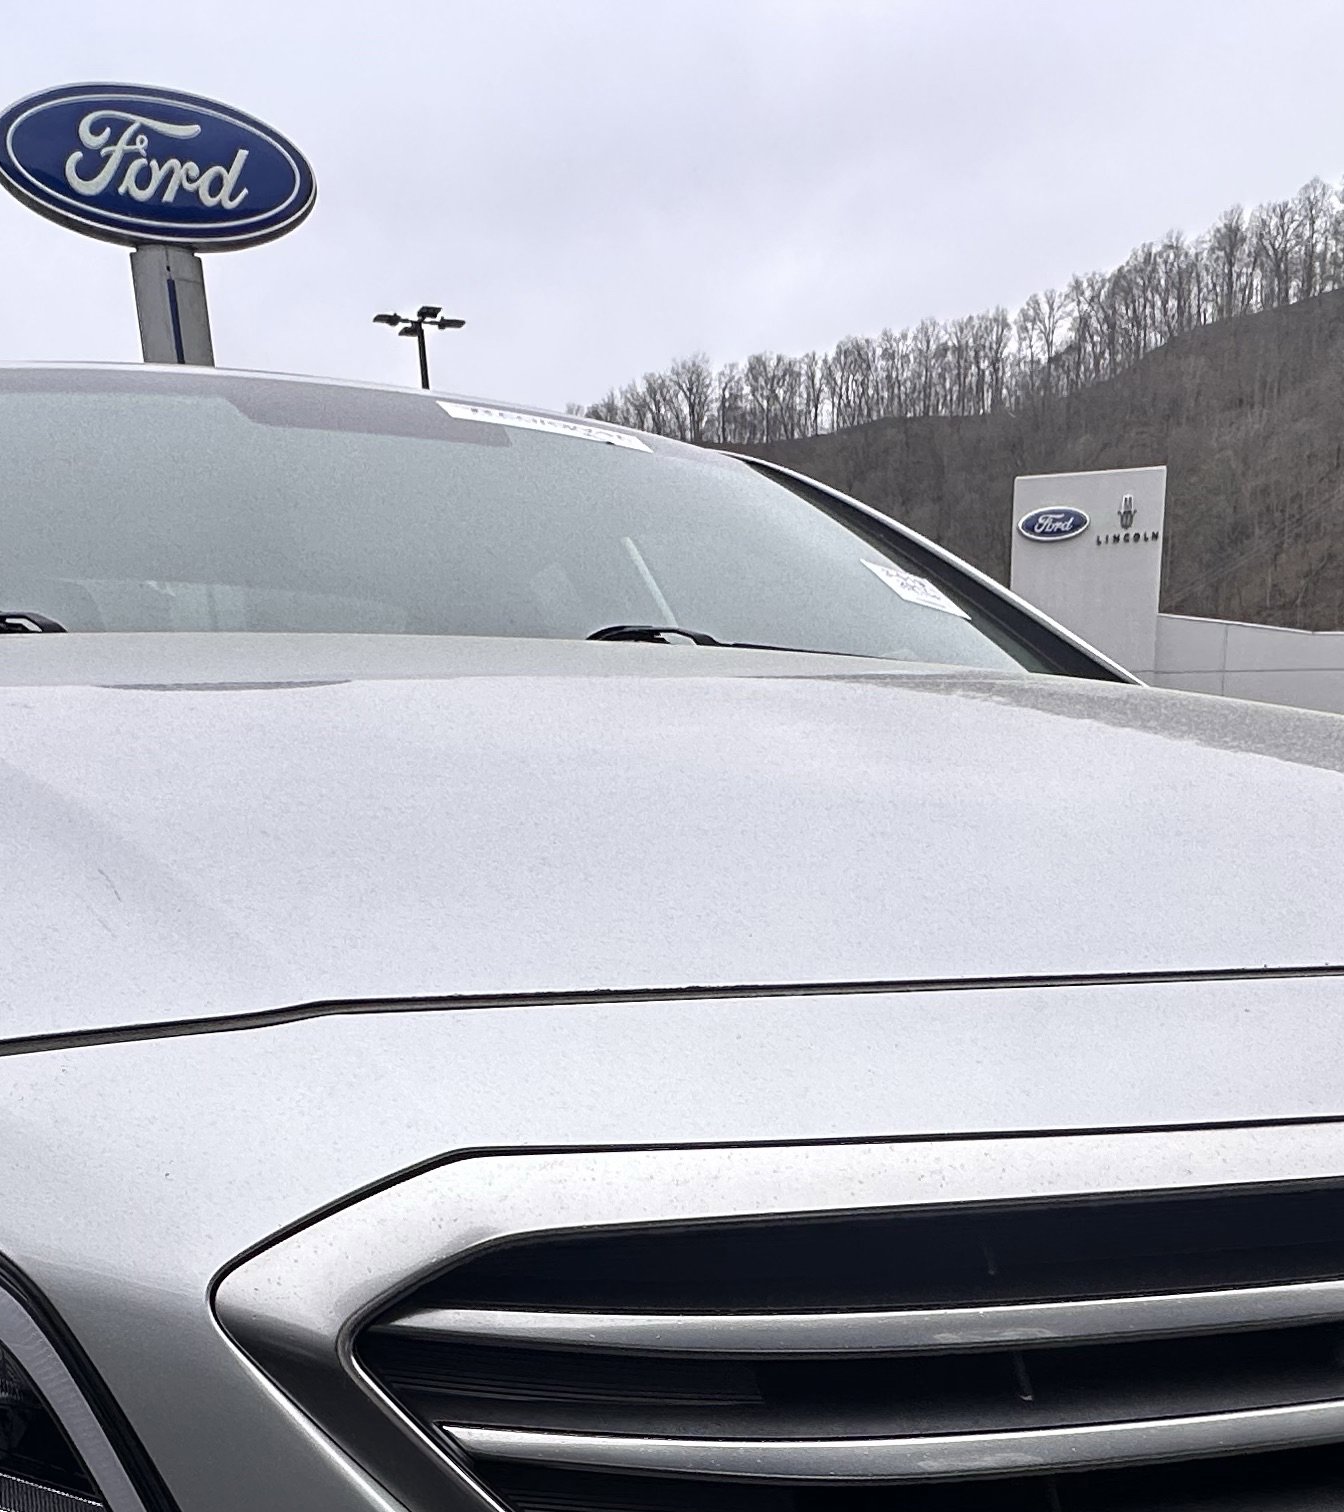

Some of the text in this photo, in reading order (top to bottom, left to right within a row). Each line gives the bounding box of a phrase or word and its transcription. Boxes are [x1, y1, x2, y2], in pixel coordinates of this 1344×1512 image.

[64, 110, 250, 210] Ford
[1034, 513, 1074, 533] Ford
[1096, 531, 1159, 546] LINCOLN
